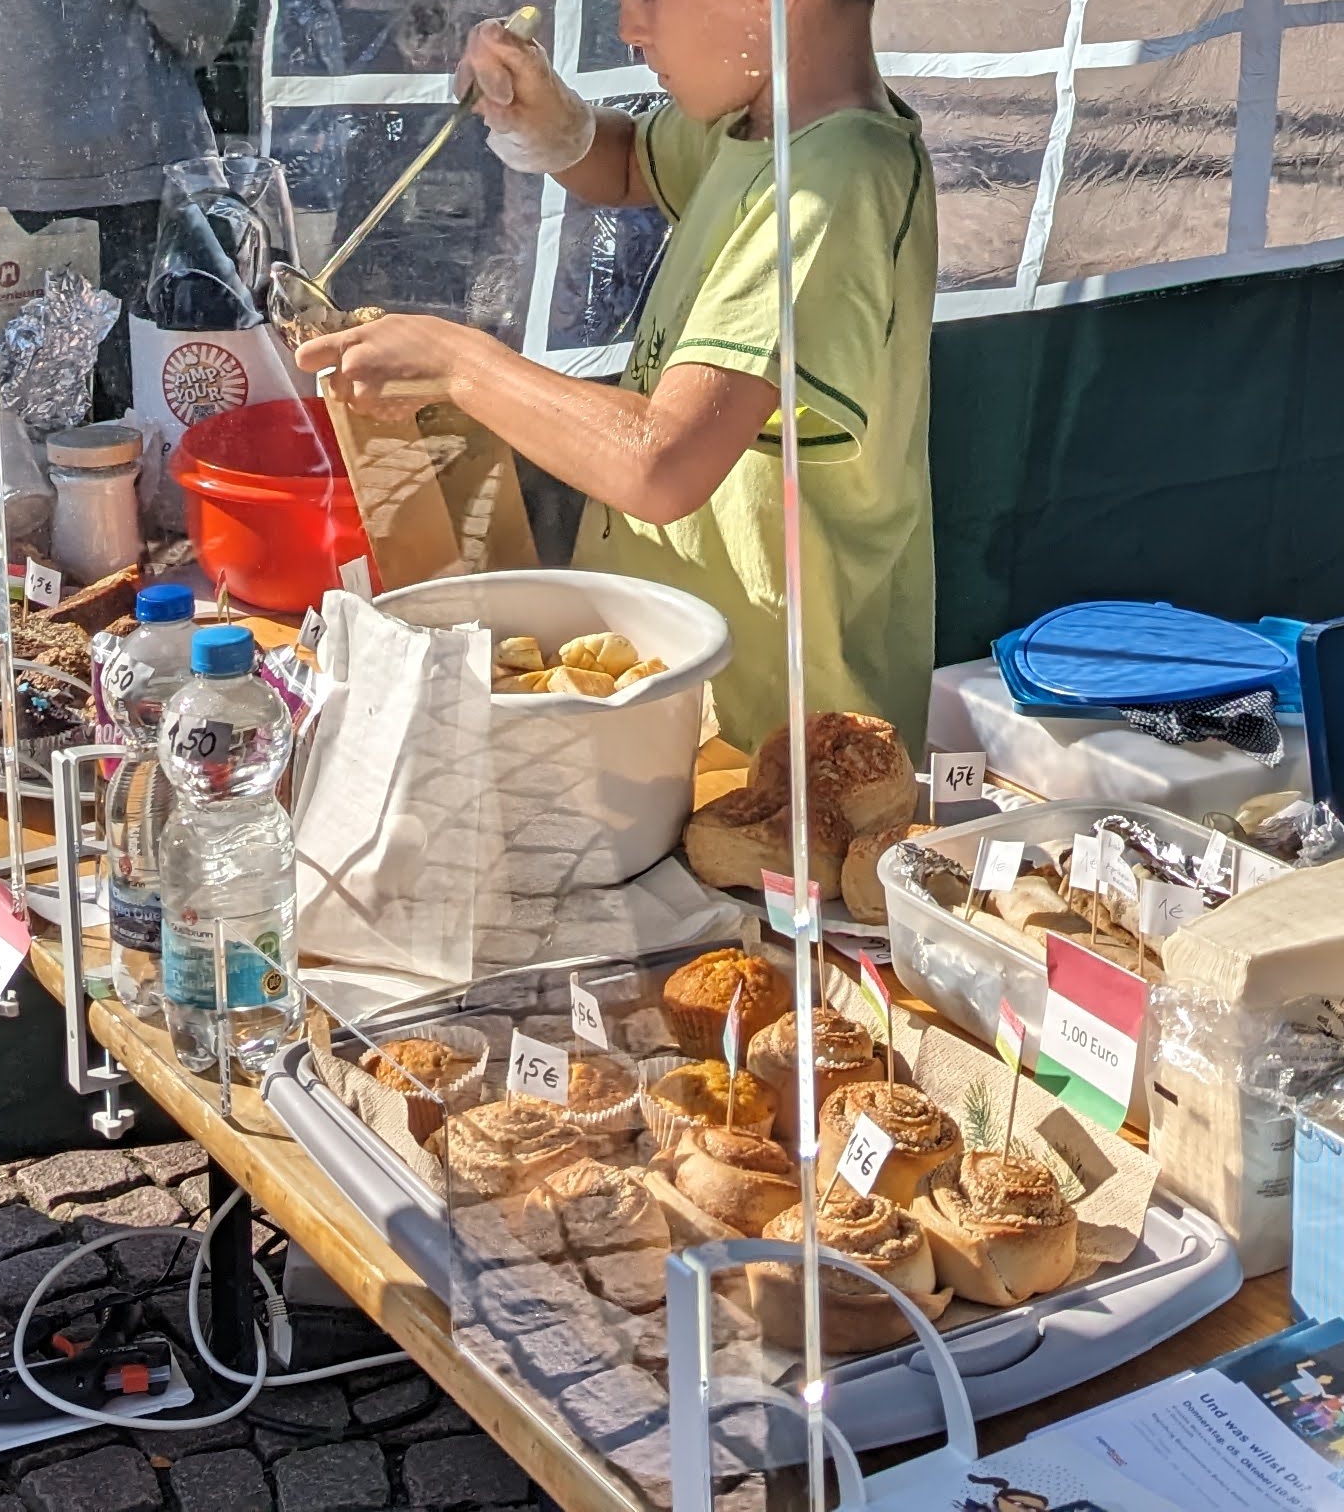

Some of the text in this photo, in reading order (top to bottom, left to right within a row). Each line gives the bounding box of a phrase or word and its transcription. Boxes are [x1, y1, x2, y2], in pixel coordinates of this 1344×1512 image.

[174, 366, 218, 386] PIMP
[174, 382, 224, 404] YOUR
[167, 721, 217, 758] 1,50
[1158, 898, 1185, 921] 1€
[1060, 1019, 1119, 1067] 1,00 Euro
[515, 1052, 560, 1088] 1,5€
[1199, 1392, 1229, 1419] Und
[1224, 1420, 1249, 1443] was
[1249, 1443, 1286, 1474] willst
